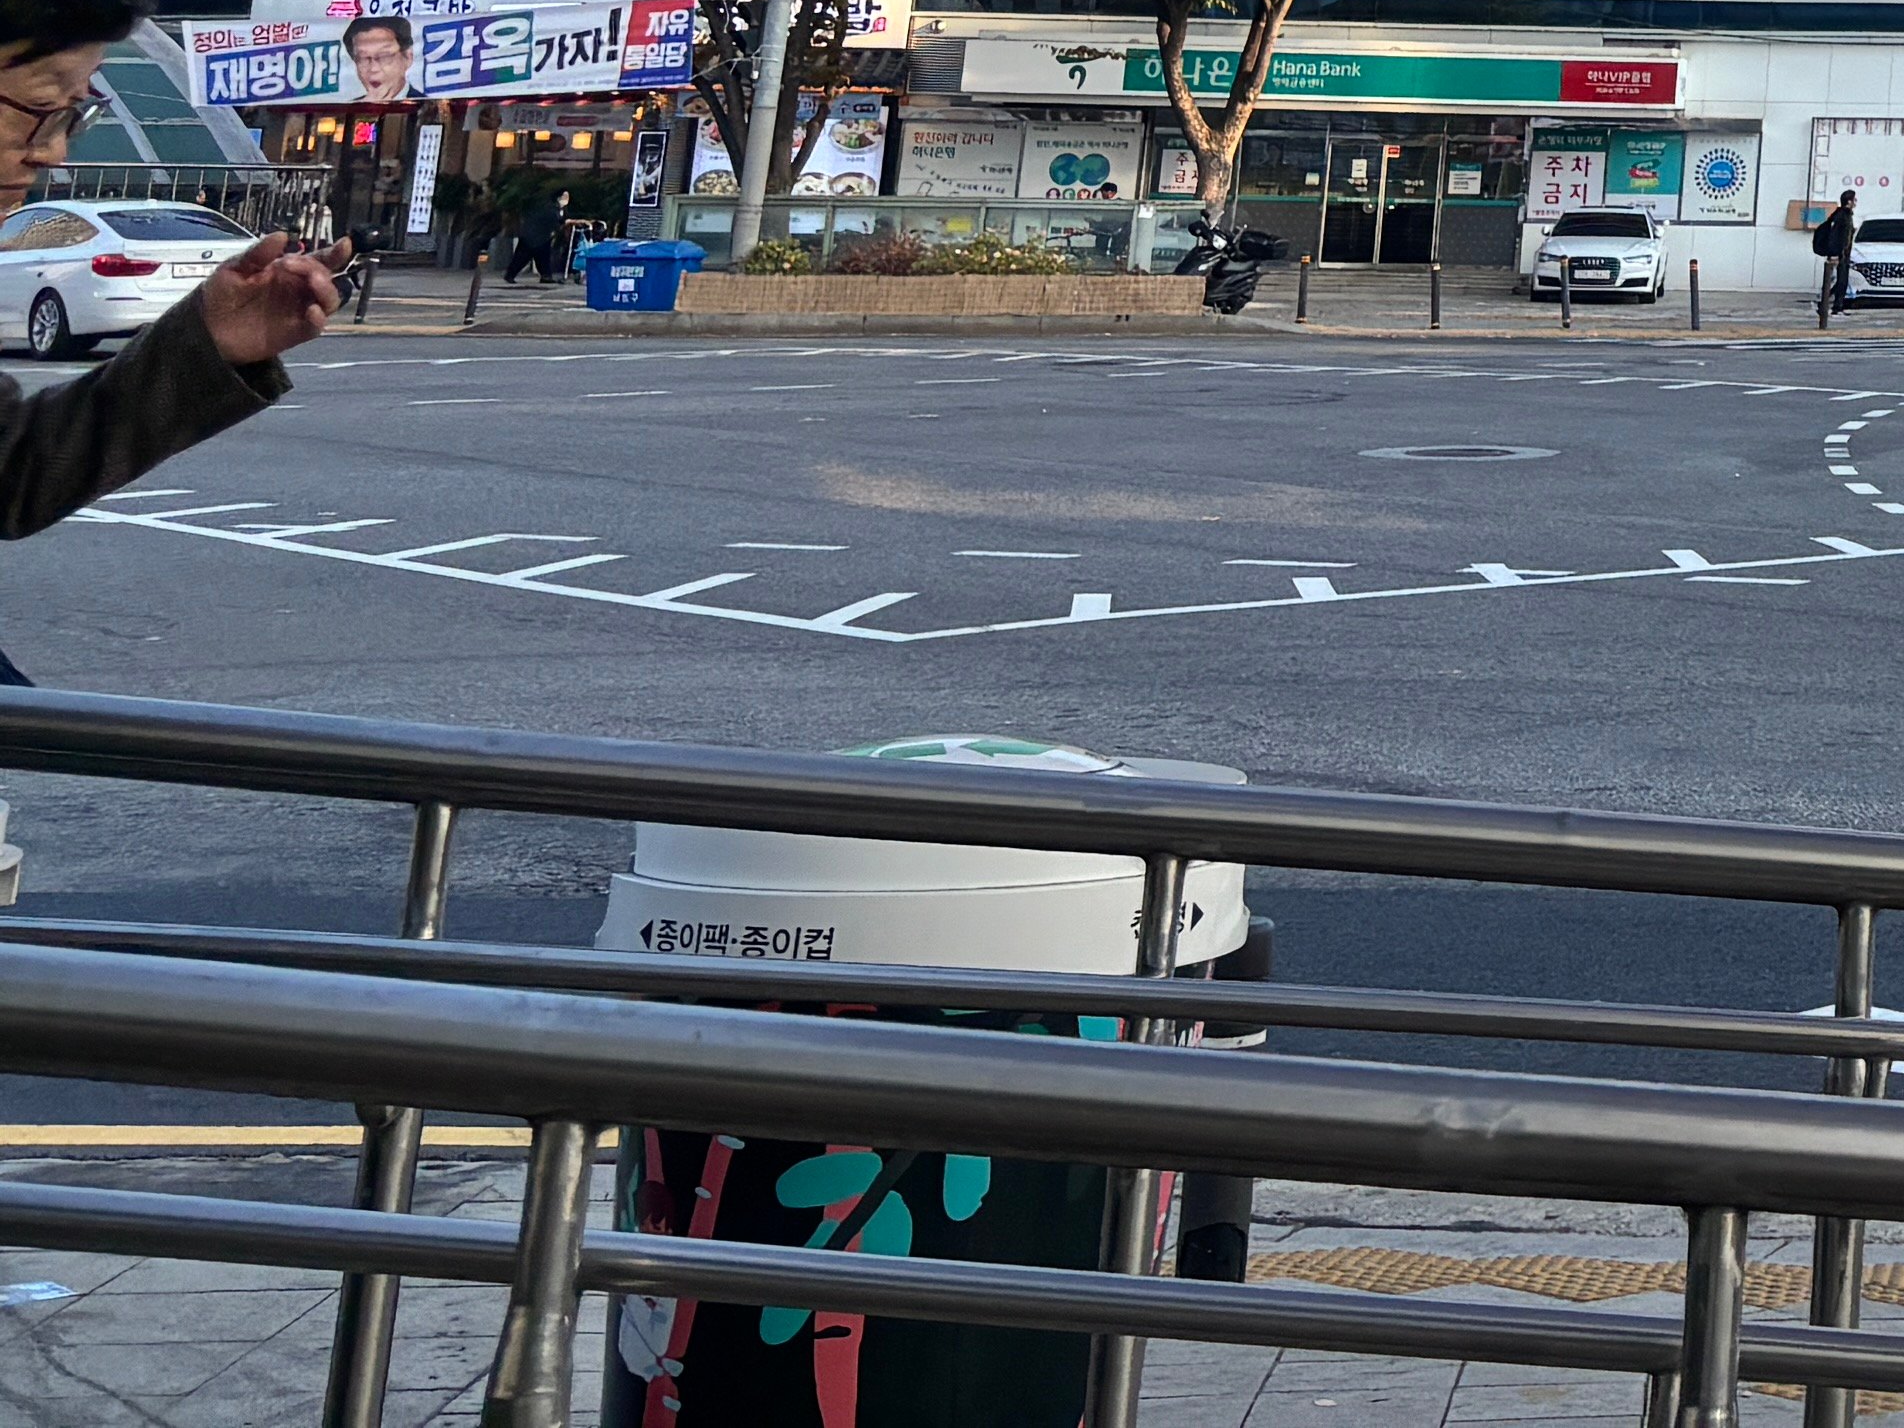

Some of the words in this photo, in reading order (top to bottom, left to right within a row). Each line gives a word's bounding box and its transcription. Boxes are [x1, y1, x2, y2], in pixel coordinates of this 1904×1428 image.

[646, 8, 690, 37] 자유
[209, 45, 339, 100] 재명아!
[423, 16, 534, 88] 감옥
[534, 7, 622, 73] 가자!
[622, 41, 688, 70] 통일당
[1144, 55, 1233, 87] 하나은
[1273, 60, 1317, 75] Hana
[1320, 61, 1361, 77] Bank
[1544, 155, 1592, 178] 주차
[1542, 183, 1587, 205] 금지
